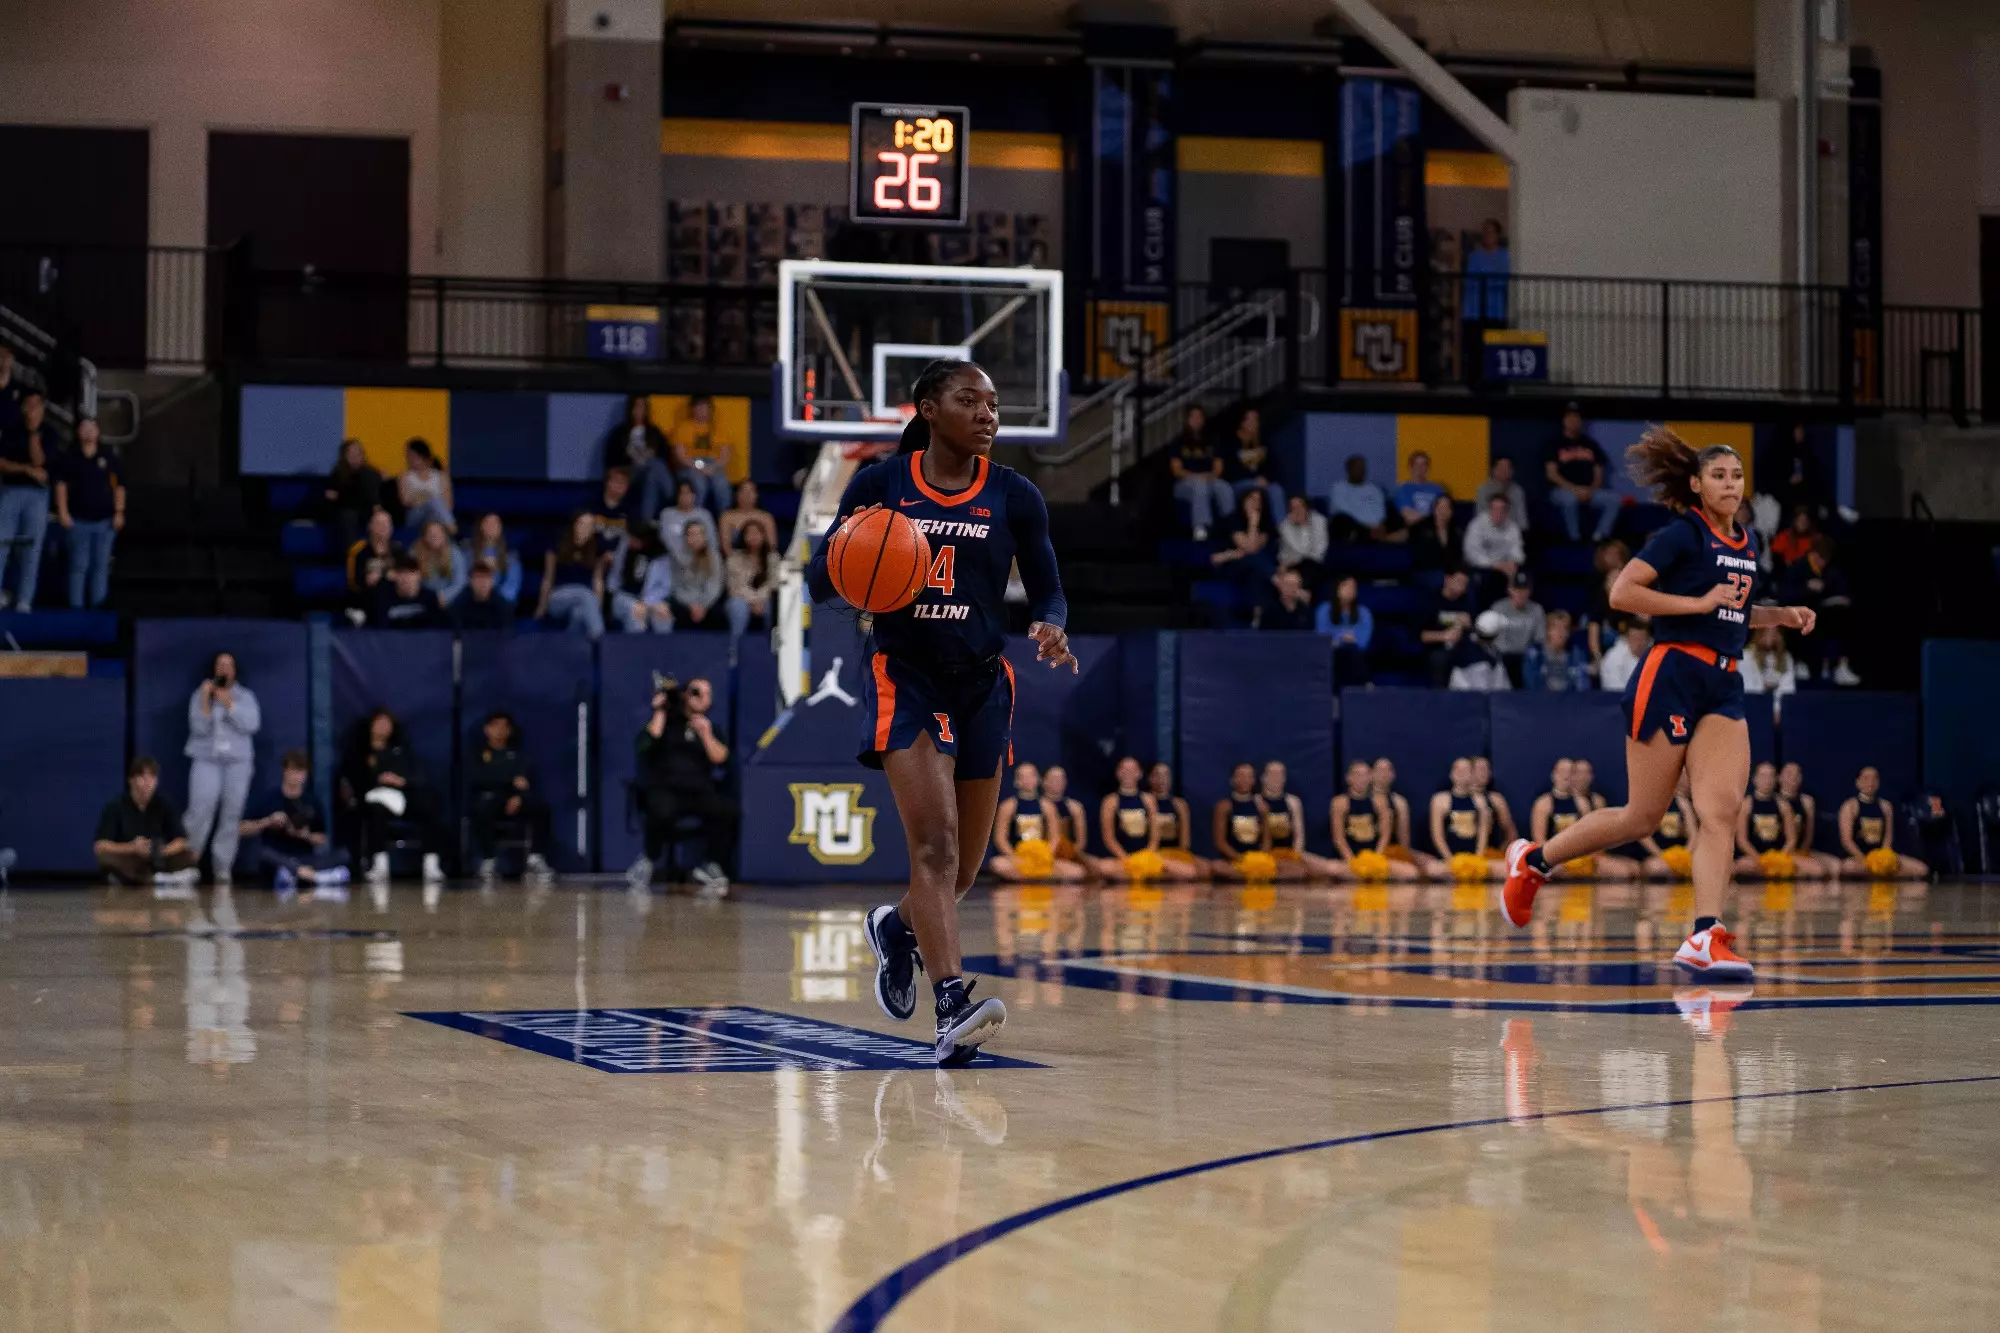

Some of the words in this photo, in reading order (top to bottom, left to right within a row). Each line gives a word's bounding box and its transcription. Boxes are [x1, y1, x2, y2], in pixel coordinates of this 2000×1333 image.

[895, 118, 954, 152] 1:20
[874, 152, 941, 211] 26
[601, 325, 647, 355] 118
[1355, 322, 1404, 373] MU
[1496, 348, 1537, 376] 119
[908, 518, 990, 539] GHTING
[927, 545, 955, 596] 4
[1716, 554, 1757, 572] FIGHTING
[913, 604, 970, 620] ILLINI
[1718, 608, 1745, 624] ILLINI
[792, 785, 874, 863] MU
